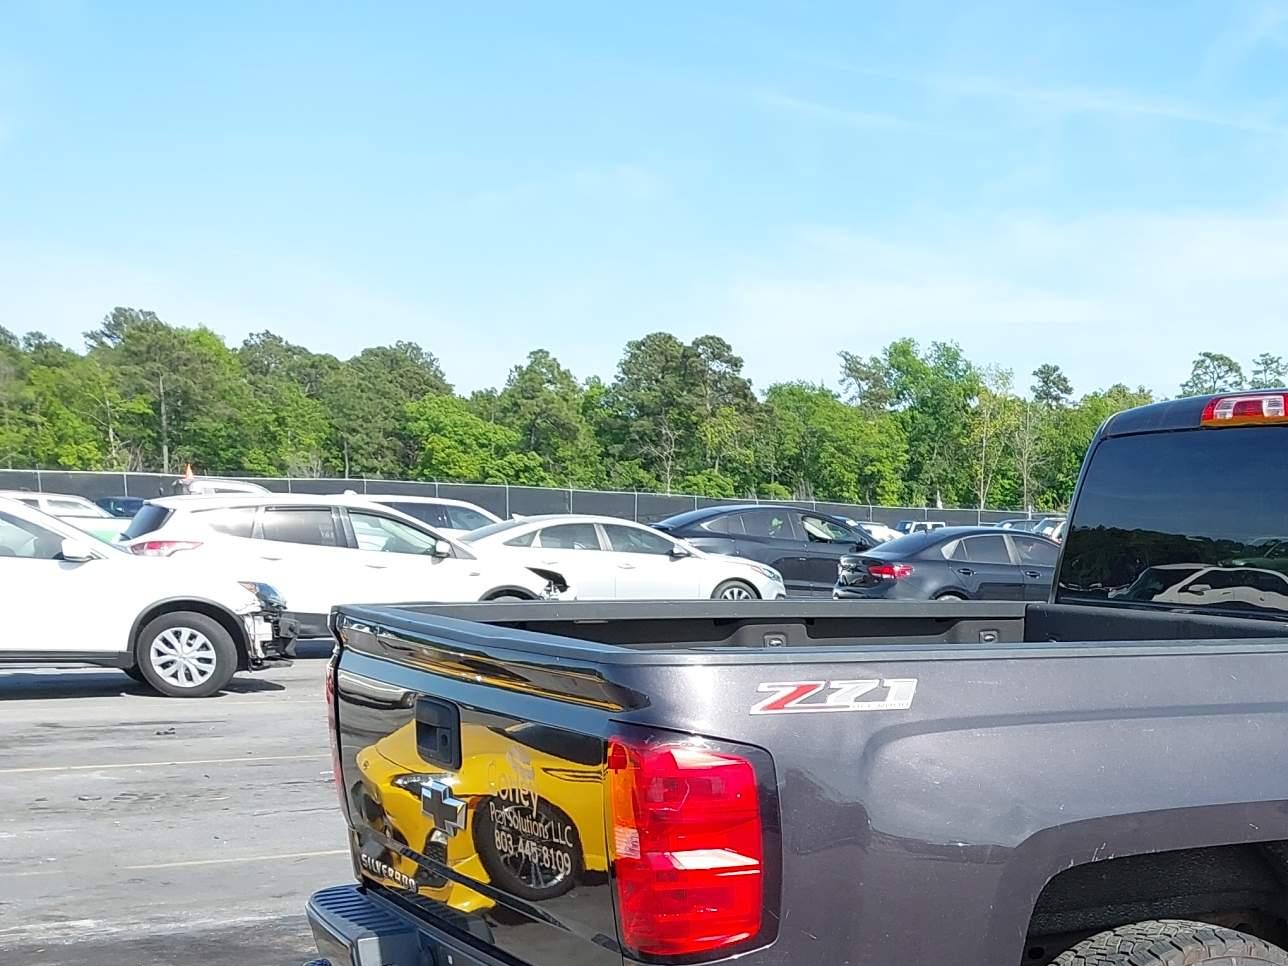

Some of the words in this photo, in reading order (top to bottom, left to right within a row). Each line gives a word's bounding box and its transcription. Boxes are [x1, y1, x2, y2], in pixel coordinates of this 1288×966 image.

[749, 678, 918, 715] Z71
[551, 820, 573, 848] LLC
[361, 854, 417, 893] SILVERADO
